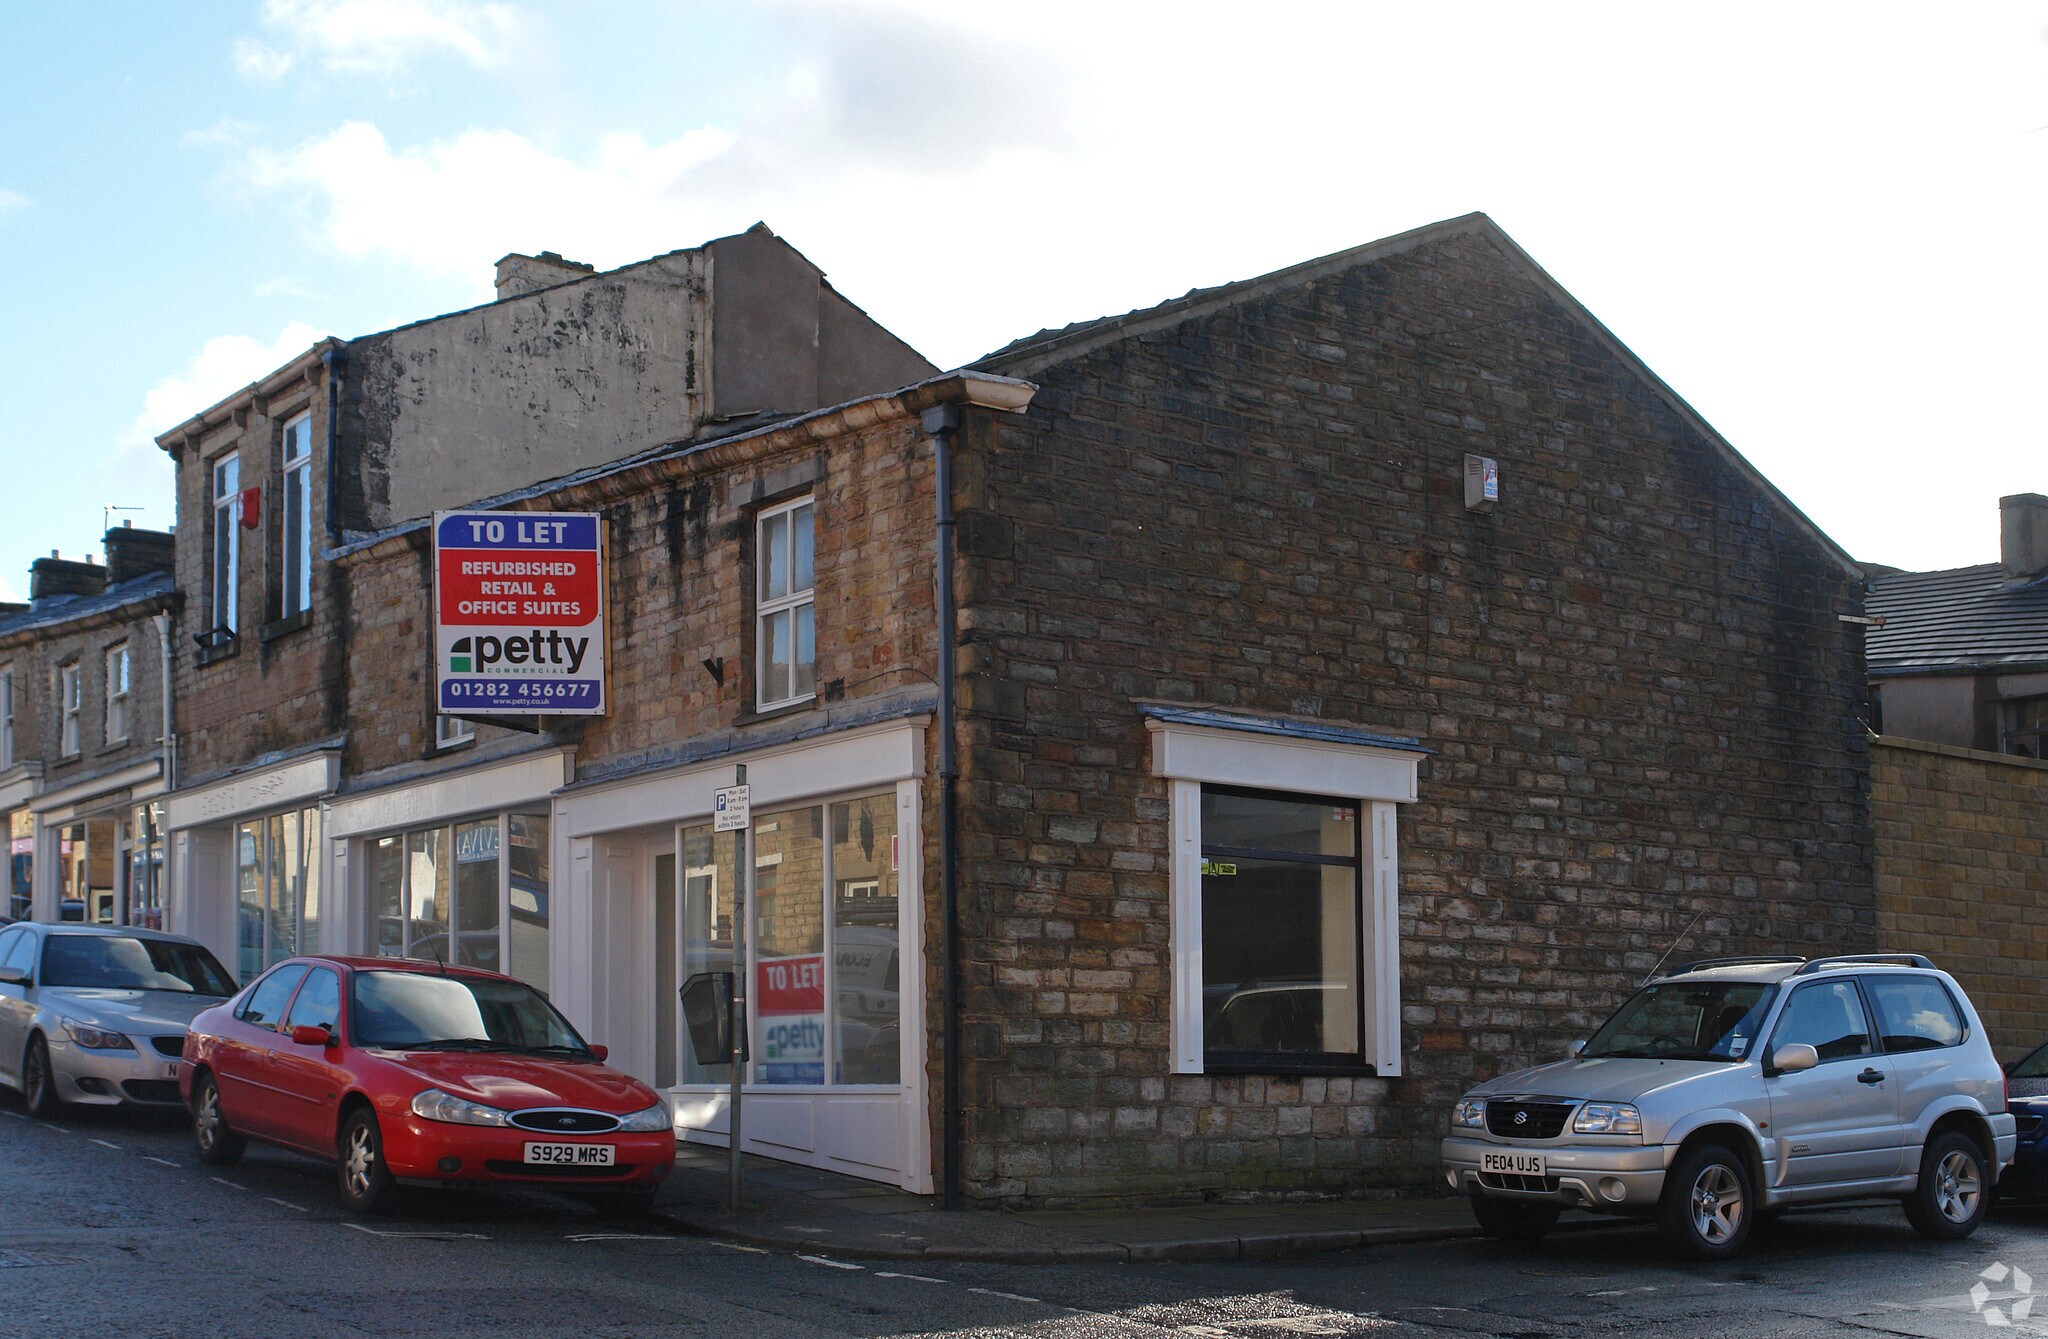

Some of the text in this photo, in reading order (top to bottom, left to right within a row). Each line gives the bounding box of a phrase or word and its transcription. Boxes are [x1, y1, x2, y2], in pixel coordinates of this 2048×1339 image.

[468, 520, 568, 544] TO LET
[461, 561, 576, 576] REFURBISHED
[481, 581, 556, 596] RETAIL &
[458, 600, 581, 615] OFFICE SUITES
[475, 629, 589, 675] petty
[451, 683, 591, 697] 01282 456677
[492, 698, 550, 706] www.petty.co.uk
[766, 962, 819, 991] TO LET
[531, 1145, 609, 1163] S929 MRS
[1485, 1154, 1540, 1172] PE04 UJS
